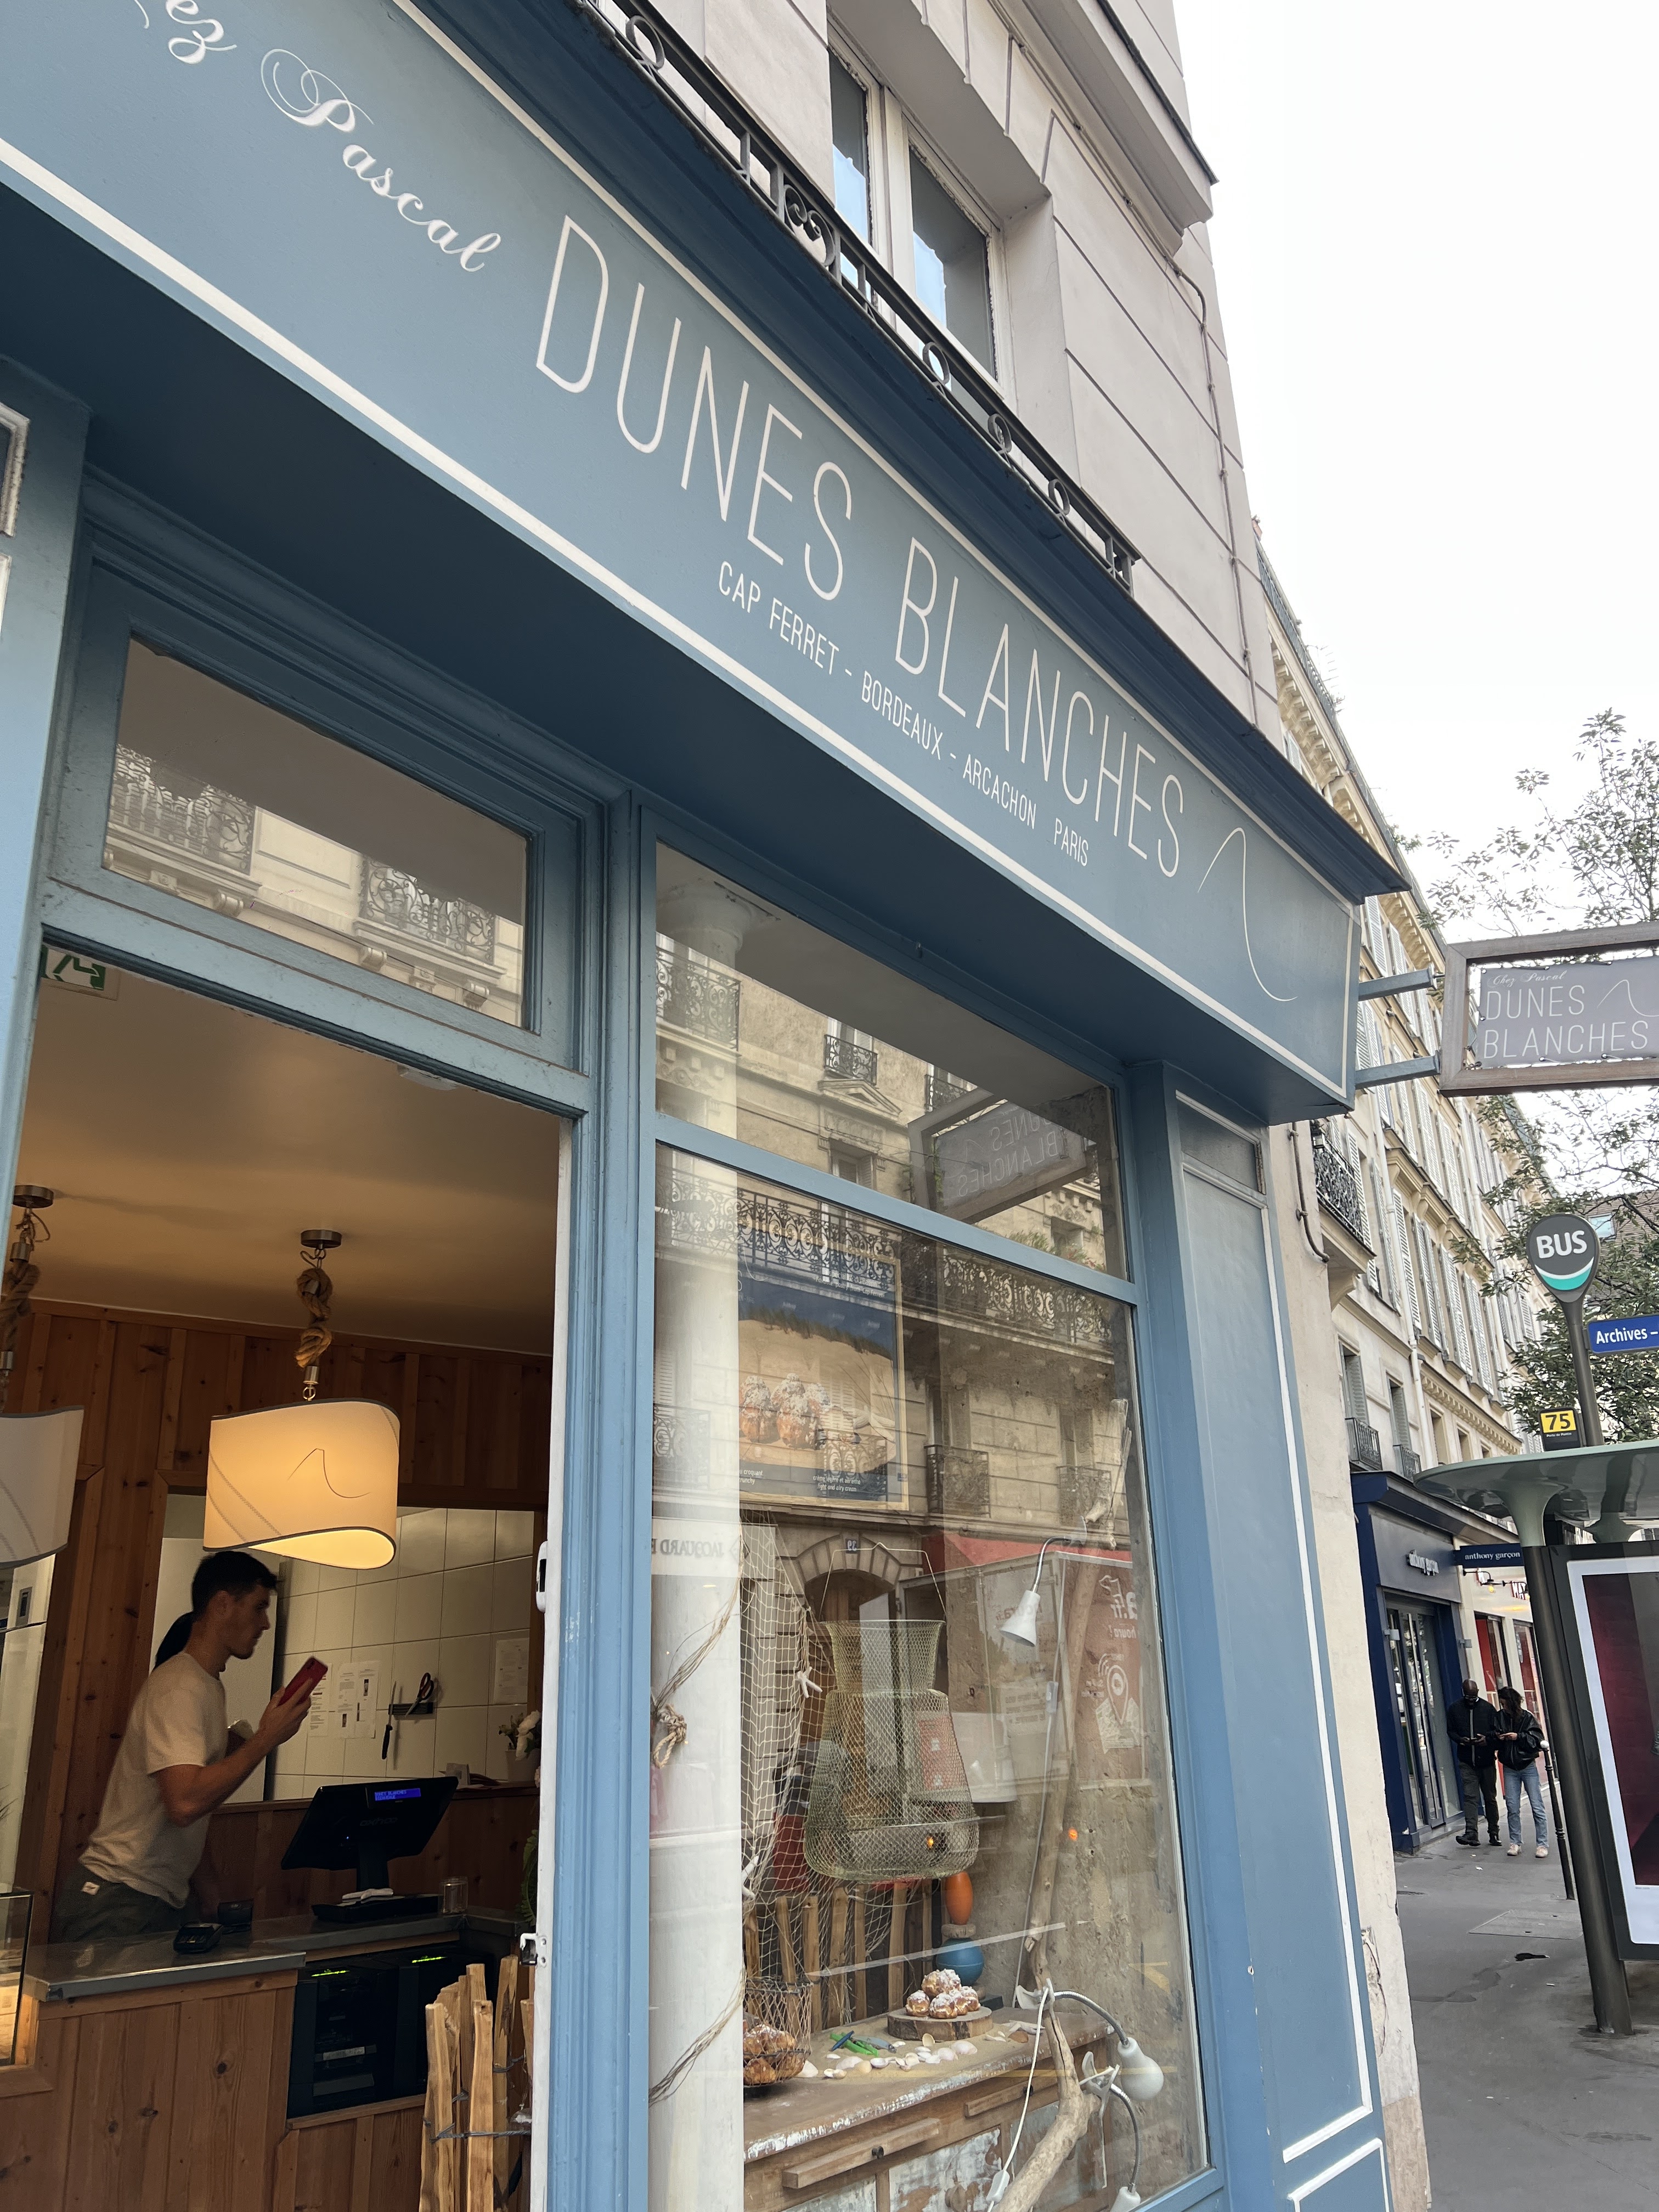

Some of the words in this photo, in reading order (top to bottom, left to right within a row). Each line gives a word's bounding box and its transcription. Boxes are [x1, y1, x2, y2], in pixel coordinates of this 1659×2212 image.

[136, 0, 236, 64] ez
[261, 48, 501, 272] Pascal
[536, 215, 852, 600] DUNES
[895, 537, 1183, 878] BLANCHES
[719, 561, 761, 613] CAP
[769, 597, 839, 675] FERRET
[861, 670, 944, 760] BORDEAUX
[963, 753, 1036, 830] ARCACHON
[1054, 817, 1088, 867] PARIS
[1487, 974, 1516, 988] Chez
[1520, 970, 1567, 983] Pascal
[1486, 985, 1585, 1021] DUNES
[1483, 1020, 1649, 1059] BLANCHES
[1536, 1229, 1588, 1259] BUS
[1596, 1327, 1648, 1345] Archives
[1545, 1413, 1571, 1431] 75
[1464, 1552, 1494, 1560] anthony
[1495, 1551, 1521, 1560] garçon
